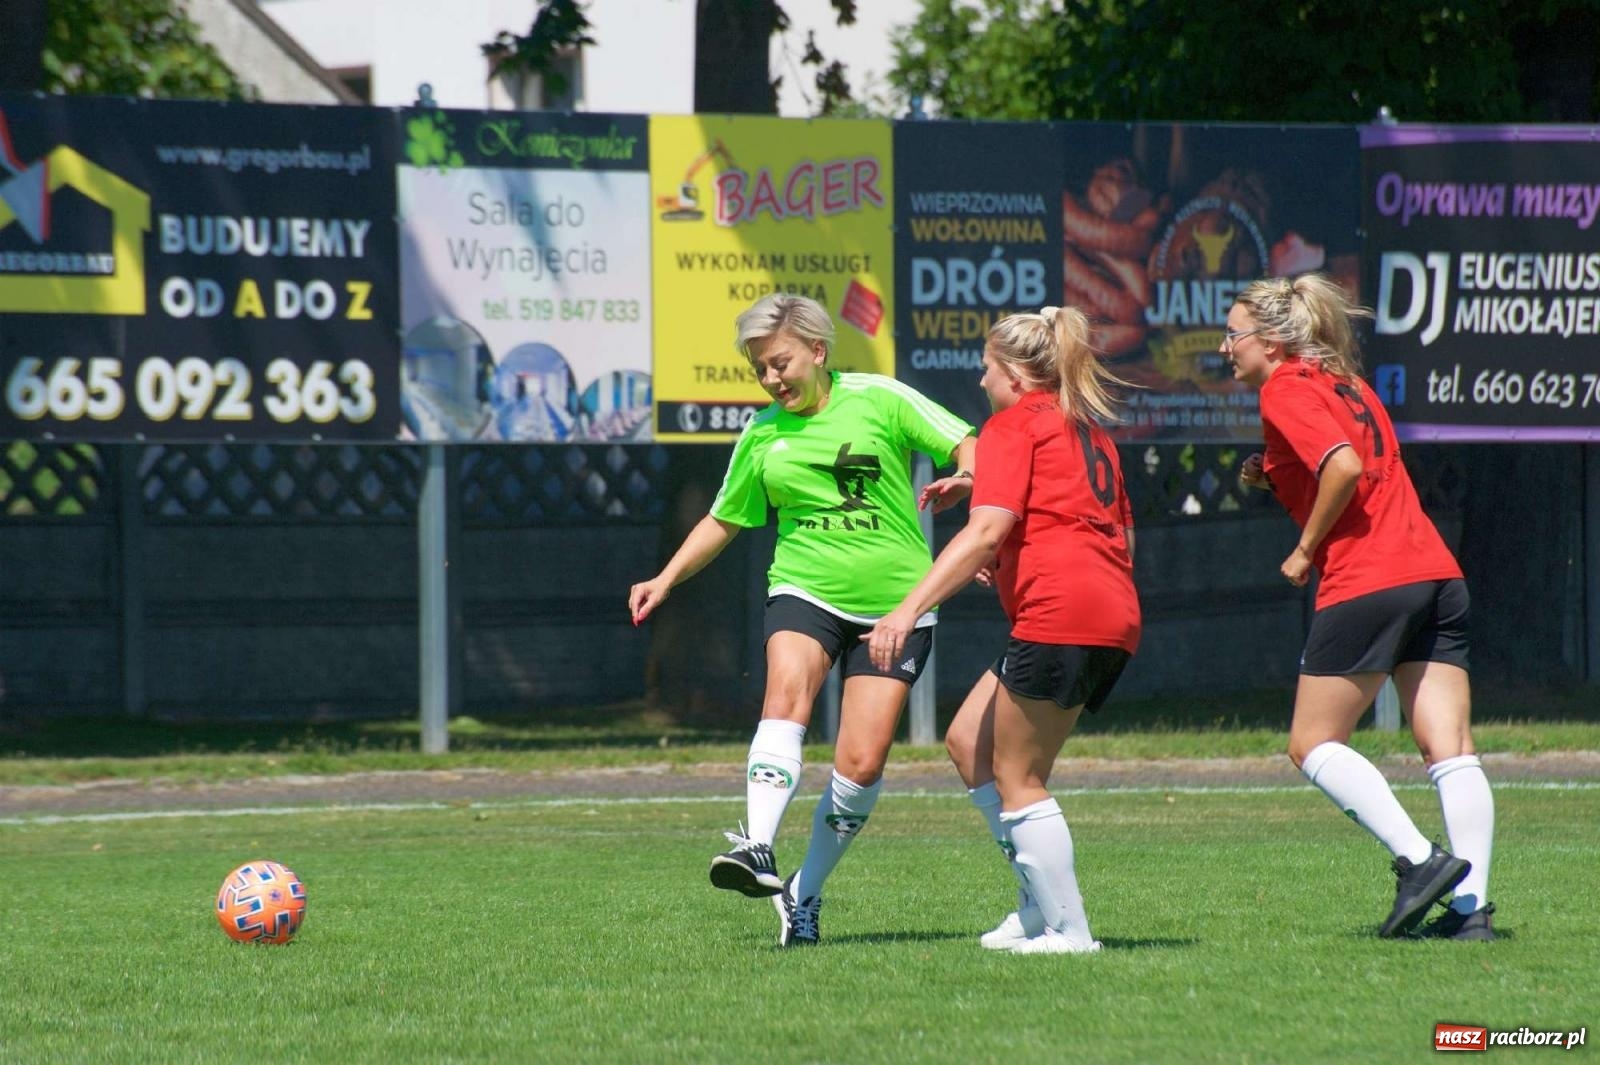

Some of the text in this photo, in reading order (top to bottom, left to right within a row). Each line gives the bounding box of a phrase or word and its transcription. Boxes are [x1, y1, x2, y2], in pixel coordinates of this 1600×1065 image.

[468, 192, 586, 228] Sala do
[714, 157, 884, 227] BAGER
[911, 192, 1047, 214] WIEPRZOWINA
[1376, 172, 1506, 227] Oprawa
[159, 215, 371, 257] BUDUJEMY
[911, 219, 1047, 243] WOŁOWINA
[676, 252, 872, 274] WYKONAM USŁUGI
[911, 245, 1047, 306] DRÓB
[160, 276, 373, 320] OD A DO Z
[520, 299, 554, 320] 519
[560, 299, 598, 322] 847
[603, 300, 640, 322] 833
[1375, 252, 1600, 347] DJ EUGENIUS
[693, 365, 756, 384] TRANS
[911, 349, 985, 370] GARMA
[7, 356, 377, 423] 665 092 363
[1427, 364, 1465, 404] tel.
[1473, 370, 1523, 404] 660
[1530, 370, 1575, 408] 623
[1076, 417, 1115, 508] 6
